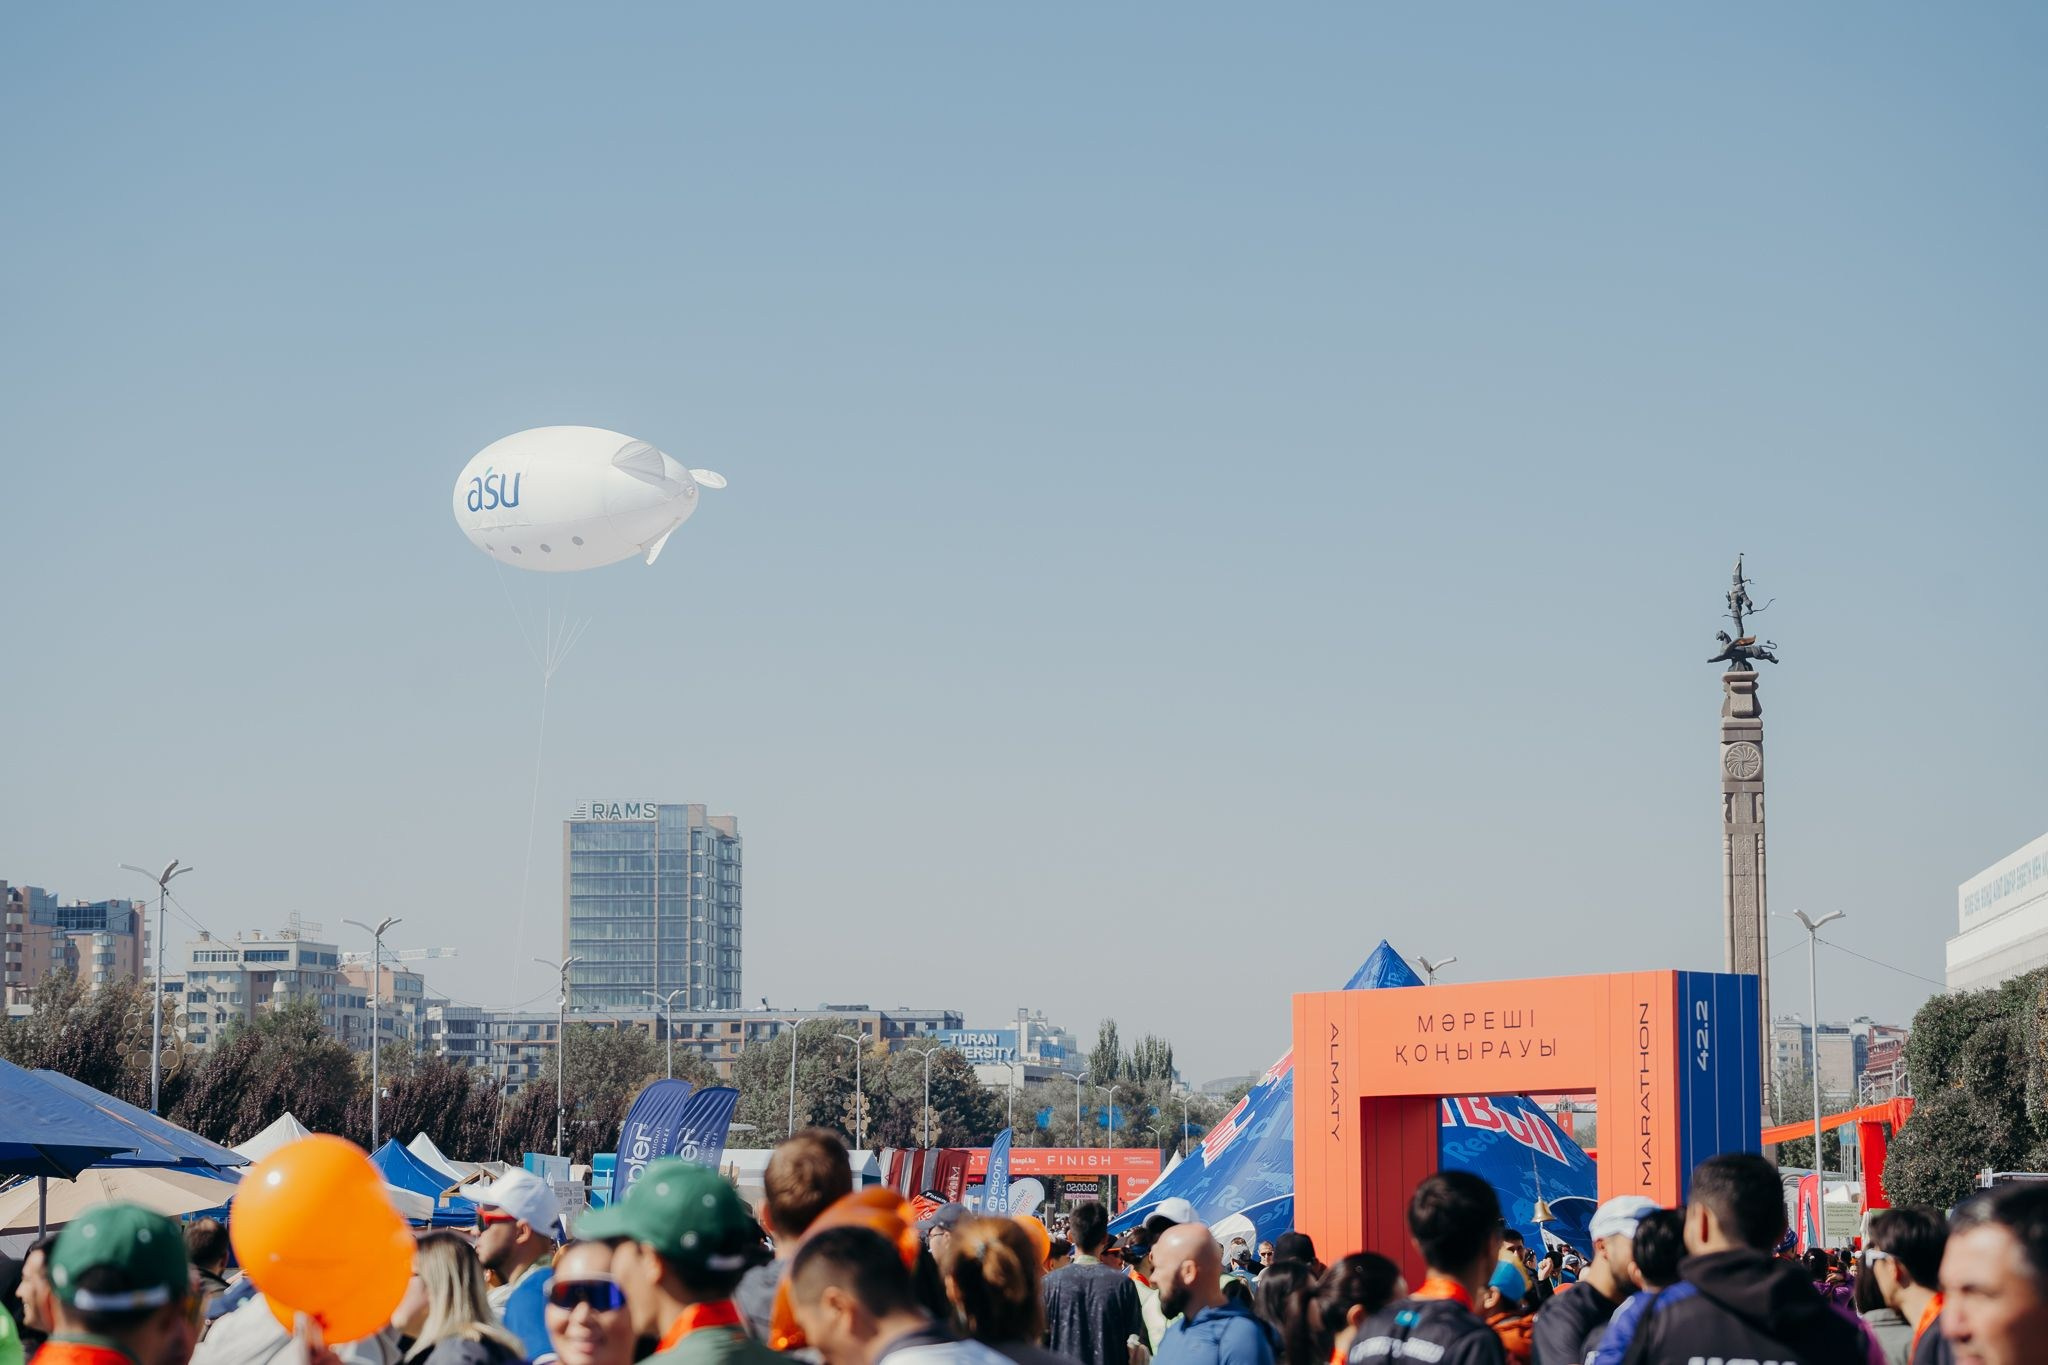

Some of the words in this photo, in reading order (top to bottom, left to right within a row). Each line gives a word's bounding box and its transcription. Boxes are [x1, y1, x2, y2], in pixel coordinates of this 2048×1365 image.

[592, 803, 656, 819] RAMS
[1418, 1009, 1534, 1033] МӘРЕШІ
[950, 1033, 998, 1045] TURAN
[1696, 1000, 1709, 1071] 42.2
[957, 1047, 1014, 1059] VERSITY
[1395, 1038, 1556, 1066] ҚОҢЫРАУЫ
[1330, 1023, 1340, 1142] ALMATY
[1639, 1003, 1652, 1186] MARATHON
[651, 1126, 663, 1161] NATIONAL
[1047, 1155, 1111, 1166] FINISH
